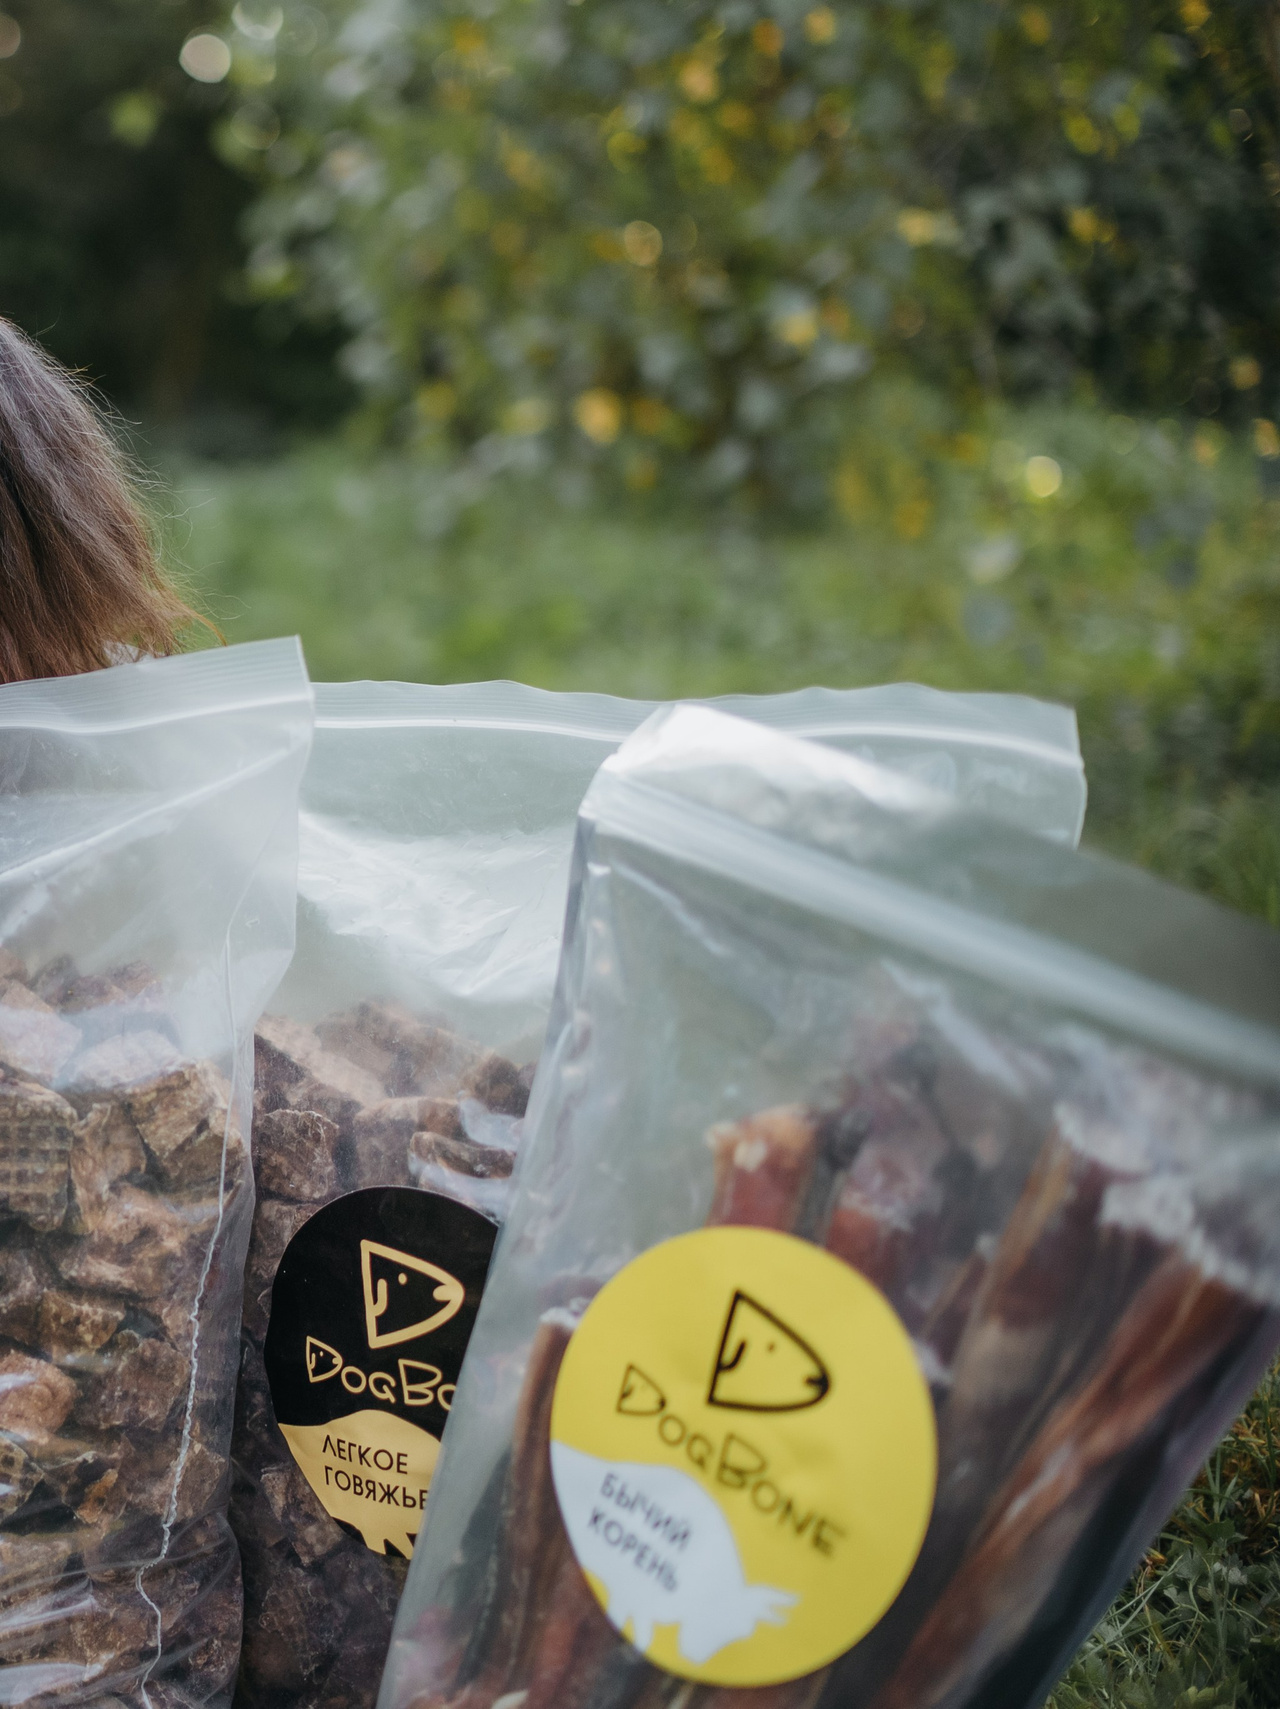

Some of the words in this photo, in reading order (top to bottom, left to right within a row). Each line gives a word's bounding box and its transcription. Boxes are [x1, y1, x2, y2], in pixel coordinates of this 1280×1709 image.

[322, 1435, 408, 1475] ЛЕГКОЕ
[324, 1466, 428, 1510] ГОВЯЖЬЕ
[600, 1472, 692, 1553] БЫЧИЙ
[587, 1507, 678, 1594] КОРЕНЬ
